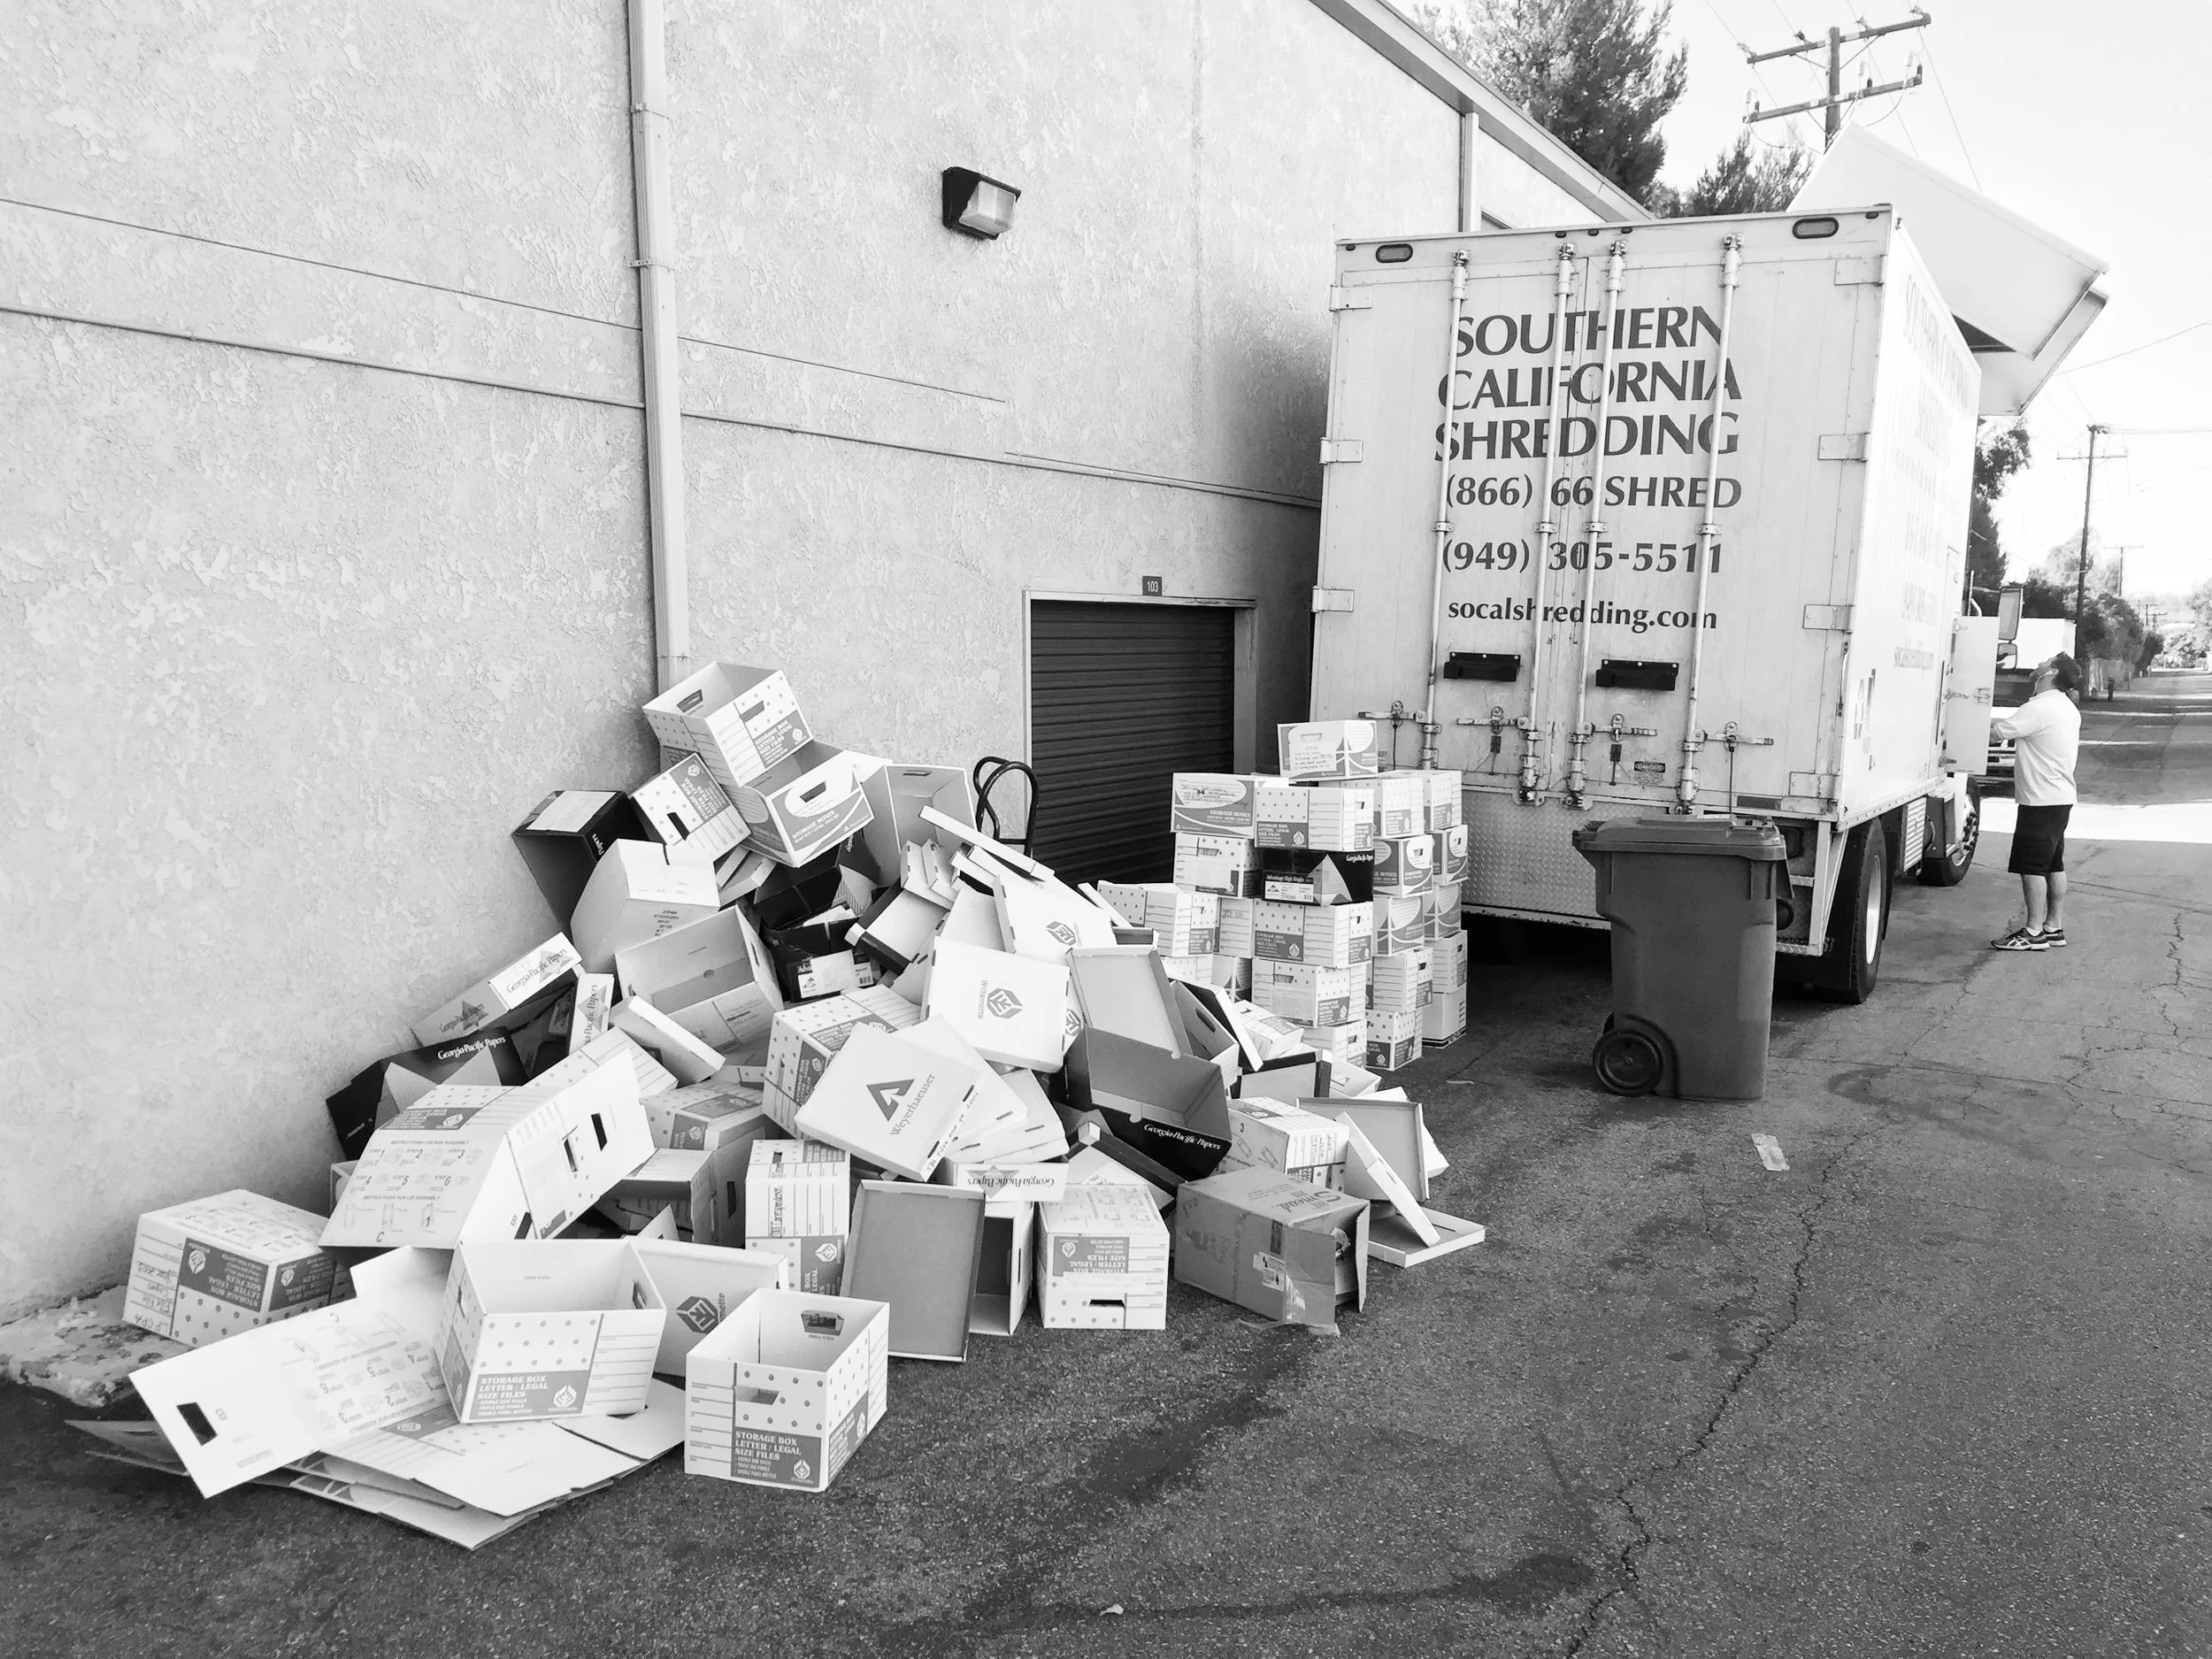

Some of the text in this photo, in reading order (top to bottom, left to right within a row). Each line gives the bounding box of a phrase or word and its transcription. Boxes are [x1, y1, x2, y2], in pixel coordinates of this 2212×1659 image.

[1450, 305, 1722, 357] SOUTHERN
[1438, 357, 1742, 411] CALIFORNIA
[1434, 411, 1740, 462] SHREDDING
[1446, 473, 1742, 509] (866) 66 SHRED
[1443, 539, 1722, 573] (949) 305-5511
[1148, 580, 1159, 593] 103
[1448, 597, 1717, 634] socalshredding.com
[978, 979, 988, 1019] Willamette
[437, 1035, 507, 1060] Georgia-Pacific Papers
[890, 1072, 935, 1136] Weyerhaeuser
[1143, 1123, 1221, 1150] Georgia-Pacific Papers
[967, 1174, 1055, 1189] Georgia-Pacific Papers
[376, 1231, 385, 1242] C
[480, 1376, 525, 1385] STORAGE
[735, 1431, 797, 1446] STORAGE BOX
[735, 1440, 767, 1450] LETTER
[773, 1444, 802, 1455] LEGAL
[734, 1448, 780, 1461] SIZE FILES
